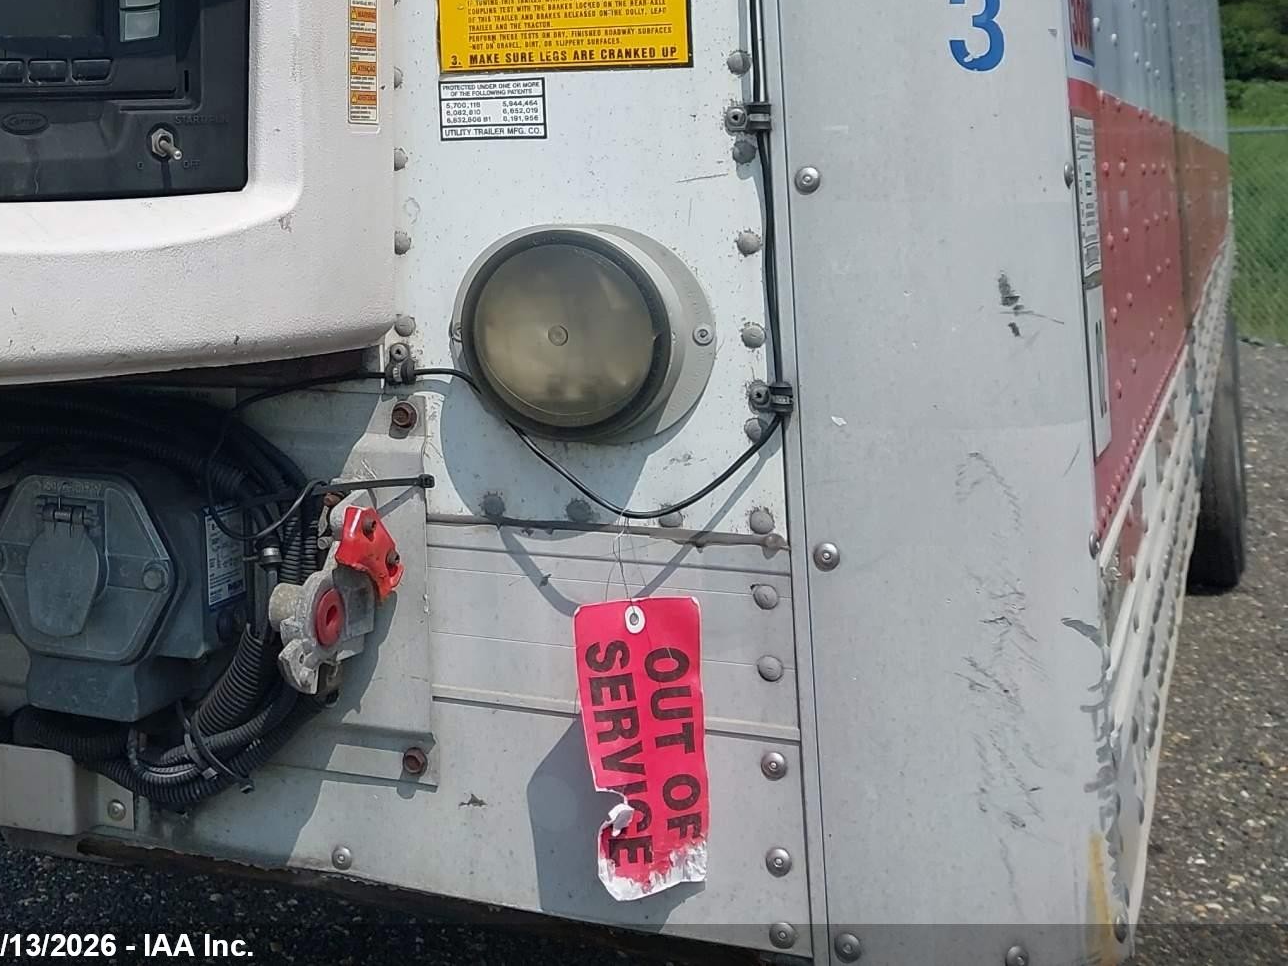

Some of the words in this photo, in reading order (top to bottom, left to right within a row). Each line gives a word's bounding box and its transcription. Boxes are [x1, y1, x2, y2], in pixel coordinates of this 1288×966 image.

[451, 55, 461, 65] 3.
[469, 54, 499, 64] MAKE
[505, 52, 534, 63] SURE
[540, 50, 567, 62] LEGS
[573, 49, 595, 61] ARE
[600, 47, 655, 59] CRANKED
[661, 46, 677, 57] UP
[442, 83, 476, 91] PROTECTED
[528, 127, 541, 135] CO.
[644, 647, 696, 755] OUT
[662, 773, 704, 840] OF
